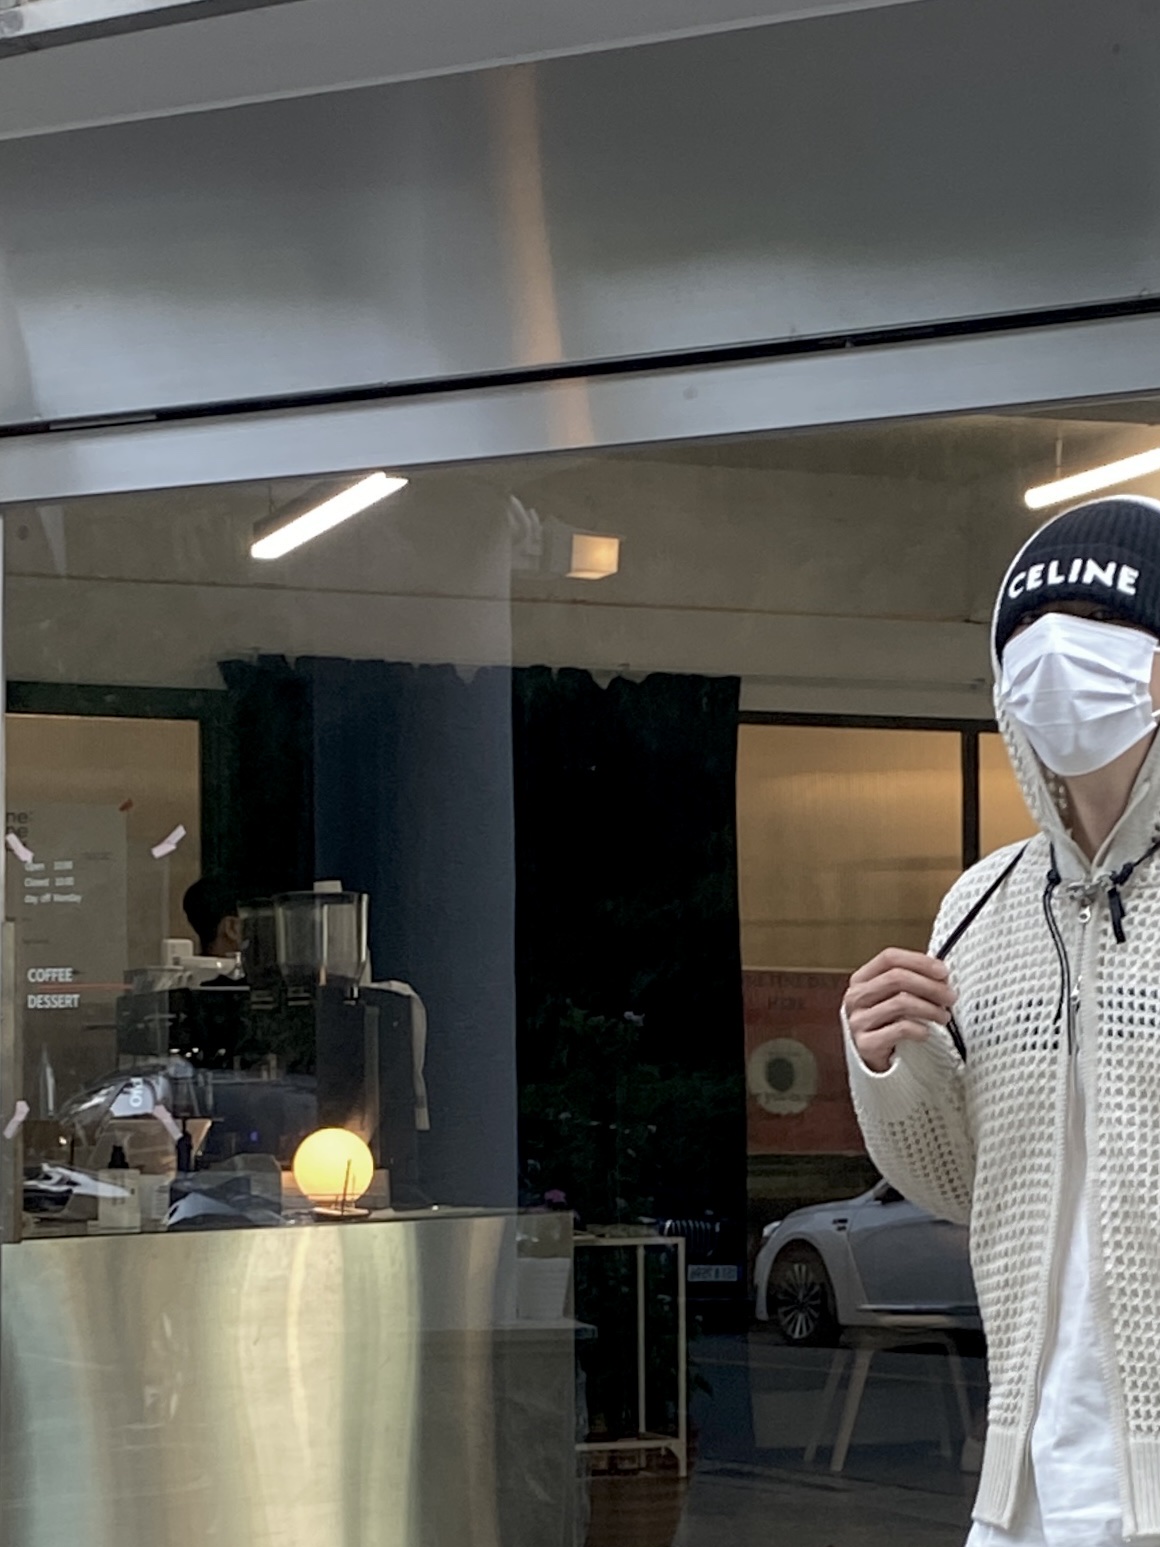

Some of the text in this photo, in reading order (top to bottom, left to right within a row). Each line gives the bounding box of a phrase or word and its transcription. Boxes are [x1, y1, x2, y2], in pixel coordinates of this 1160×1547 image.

[1008, 558, 1139, 599] CELINE
[27, 967, 73, 983] COFFEE
[27, 994, 80, 1009] DESSERT
